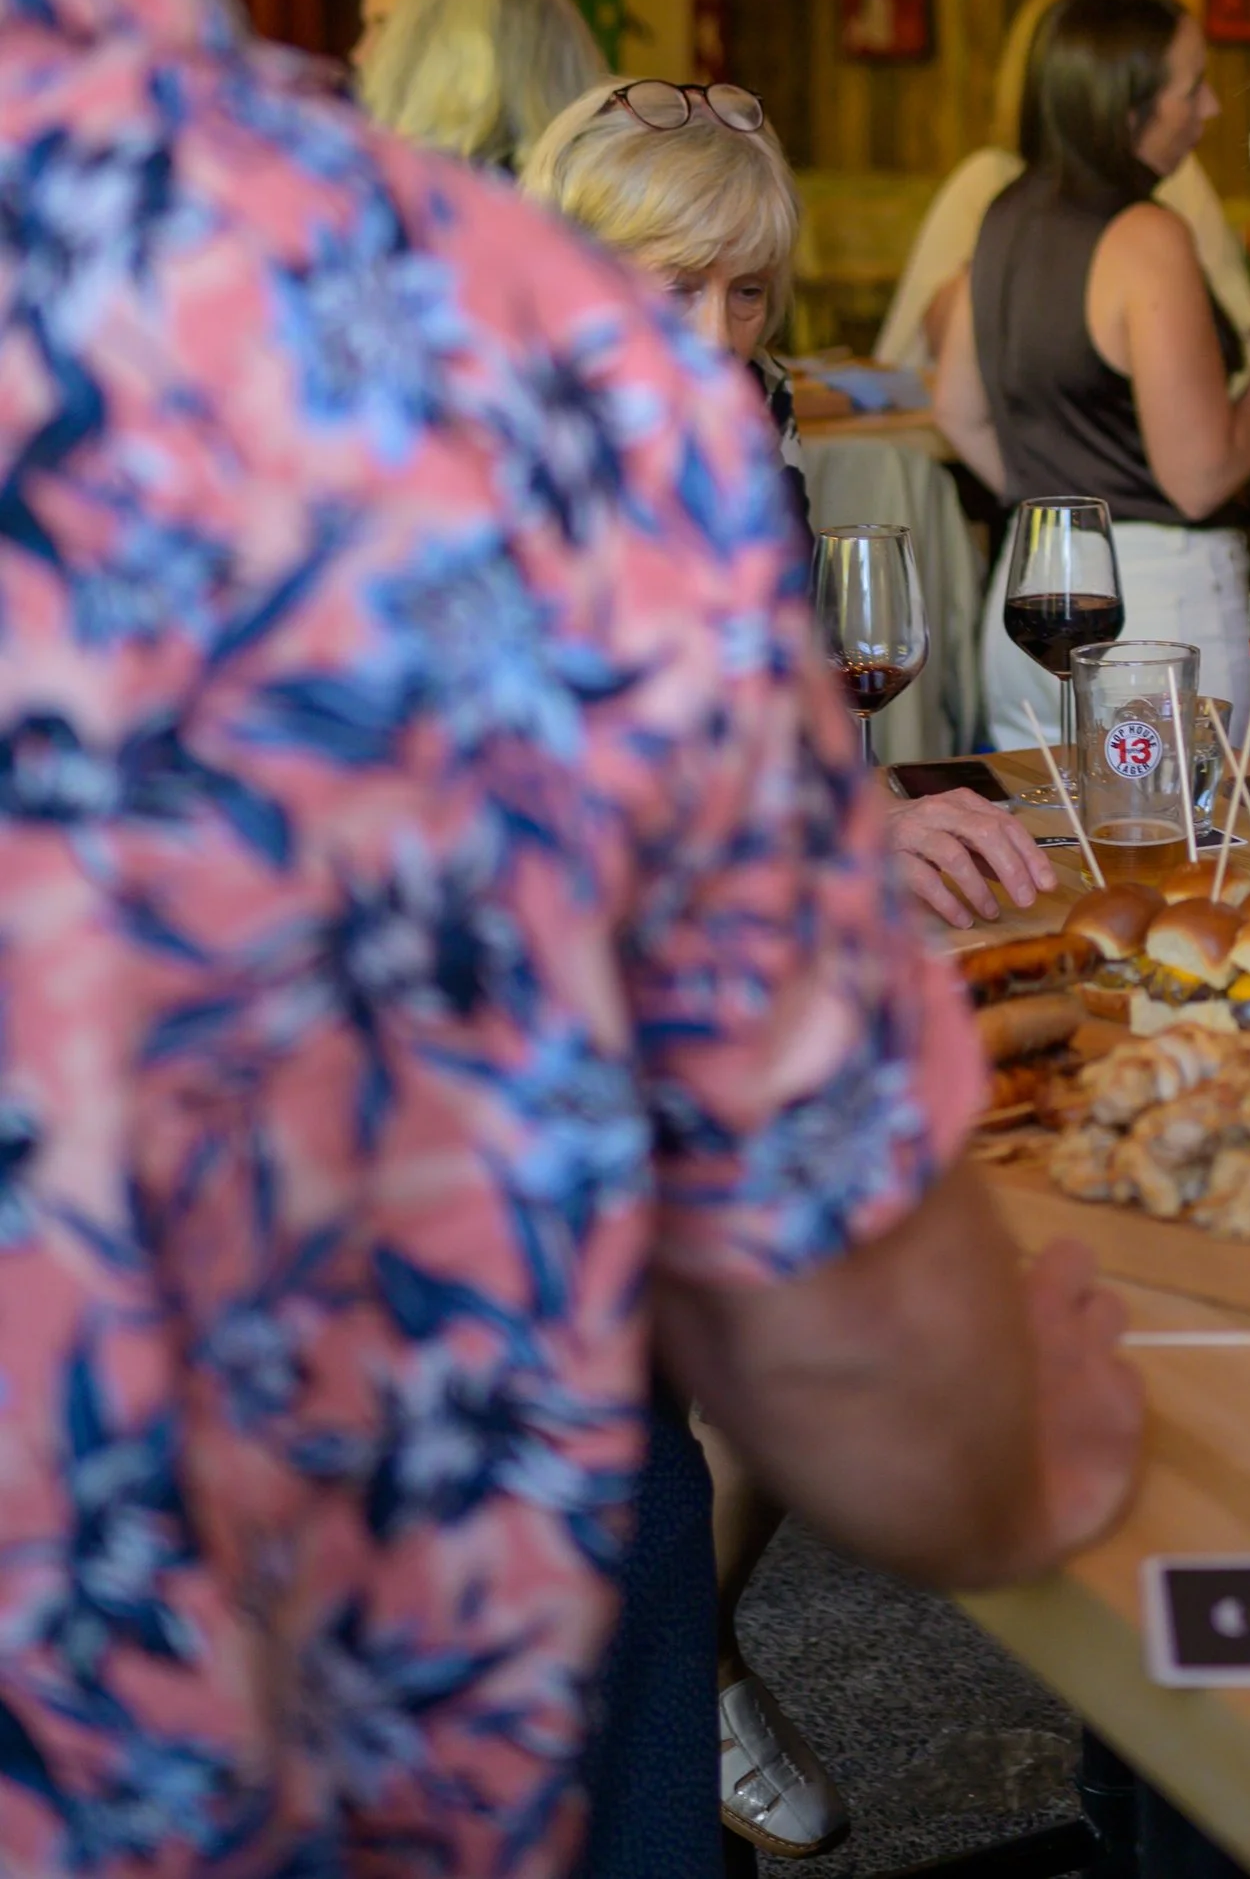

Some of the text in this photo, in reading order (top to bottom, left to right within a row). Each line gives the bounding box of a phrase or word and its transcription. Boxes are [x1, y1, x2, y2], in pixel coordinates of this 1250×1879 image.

[1110, 725, 1157, 749] HOP HOUSE
[1117, 738, 1152, 764] 13
[1117, 763, 1150, 775] LAGER
